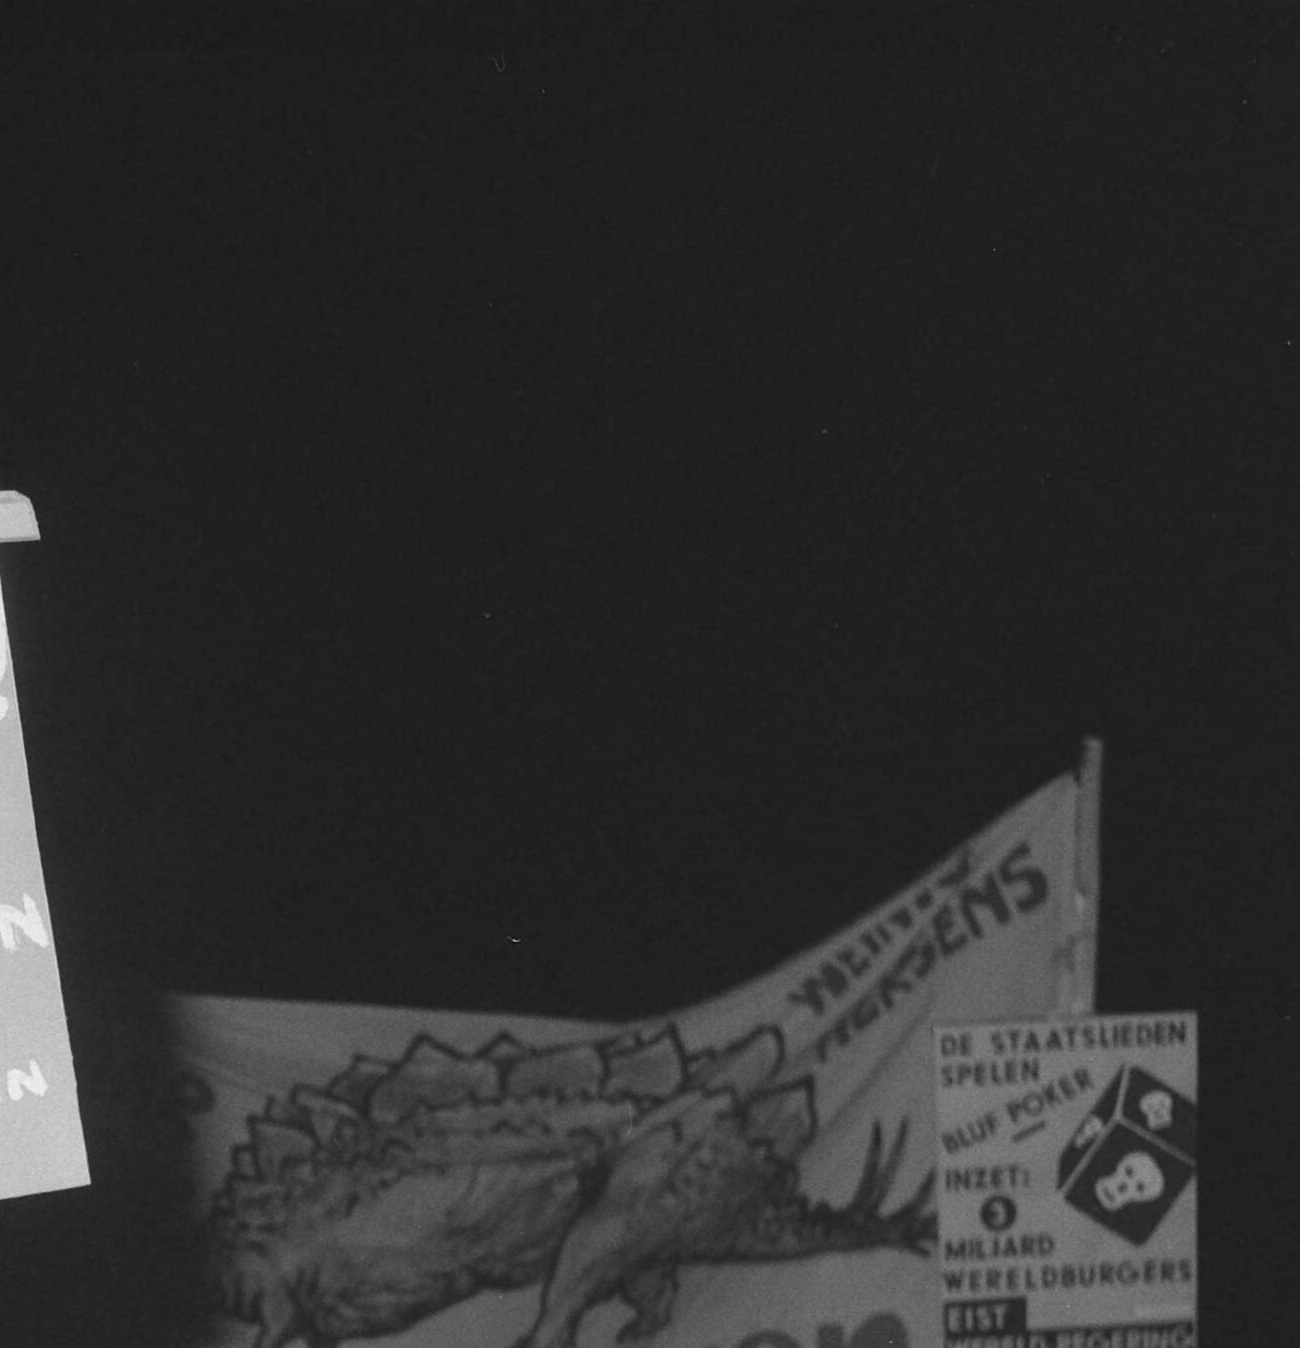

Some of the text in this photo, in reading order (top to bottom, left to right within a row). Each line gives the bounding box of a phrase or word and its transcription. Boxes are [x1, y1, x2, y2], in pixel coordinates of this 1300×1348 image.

[941, 1021, 1186, 1056] DE STAATSLIEDEN
[941, 1058, 1040, 1087] SPELEN
[1006, 1066, 1092, 1124] POKER
[945, 1166, 1030, 1191] INZET:
[941, 1258, 1192, 1292] WERELDBURGERS
[946, 1304, 1008, 1333] EIST
